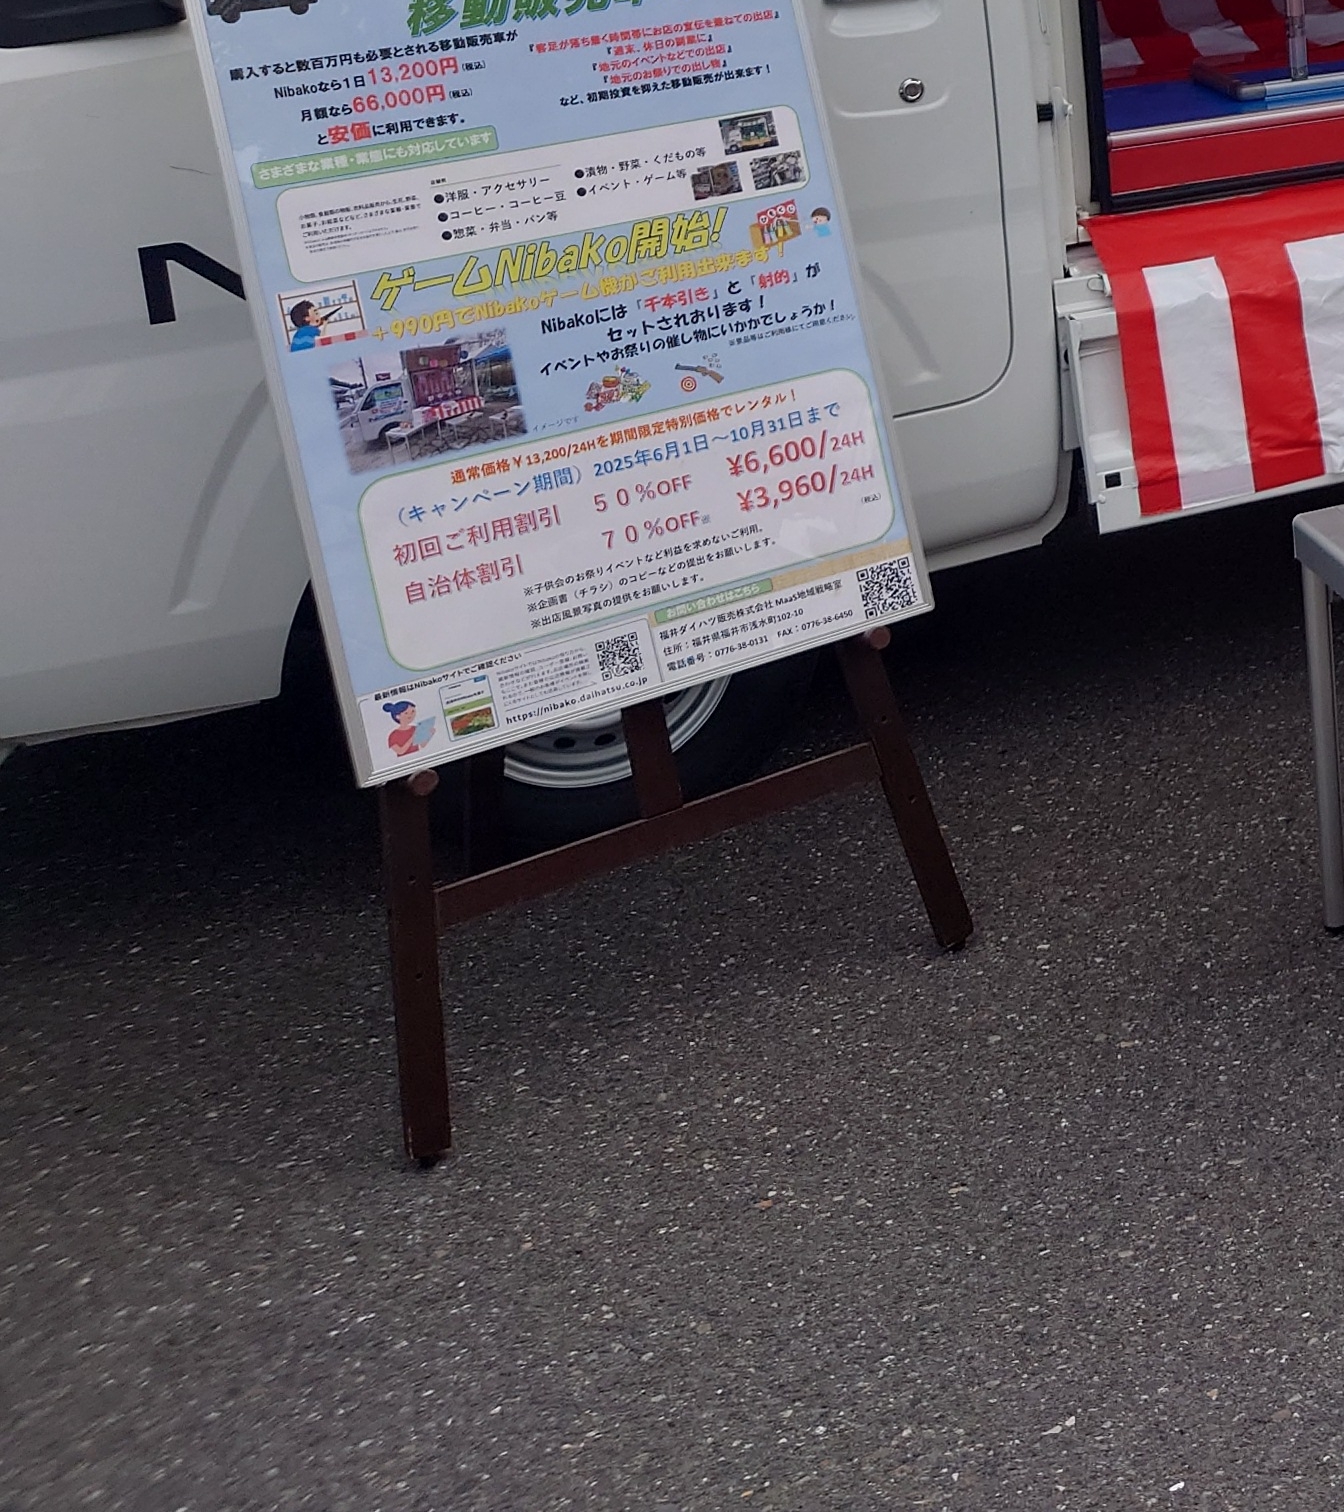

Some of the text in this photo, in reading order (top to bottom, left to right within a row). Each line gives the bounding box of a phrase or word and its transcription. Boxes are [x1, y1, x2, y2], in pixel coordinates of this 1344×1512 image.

[314, 105, 466, 147] と安価に利用できます。
[391, 503, 561, 568] 初回ご利用割引
[403, 552, 524, 605] 自治体割引
[505, 673, 648, 727] https://nibako.daihatsu.co.jp
